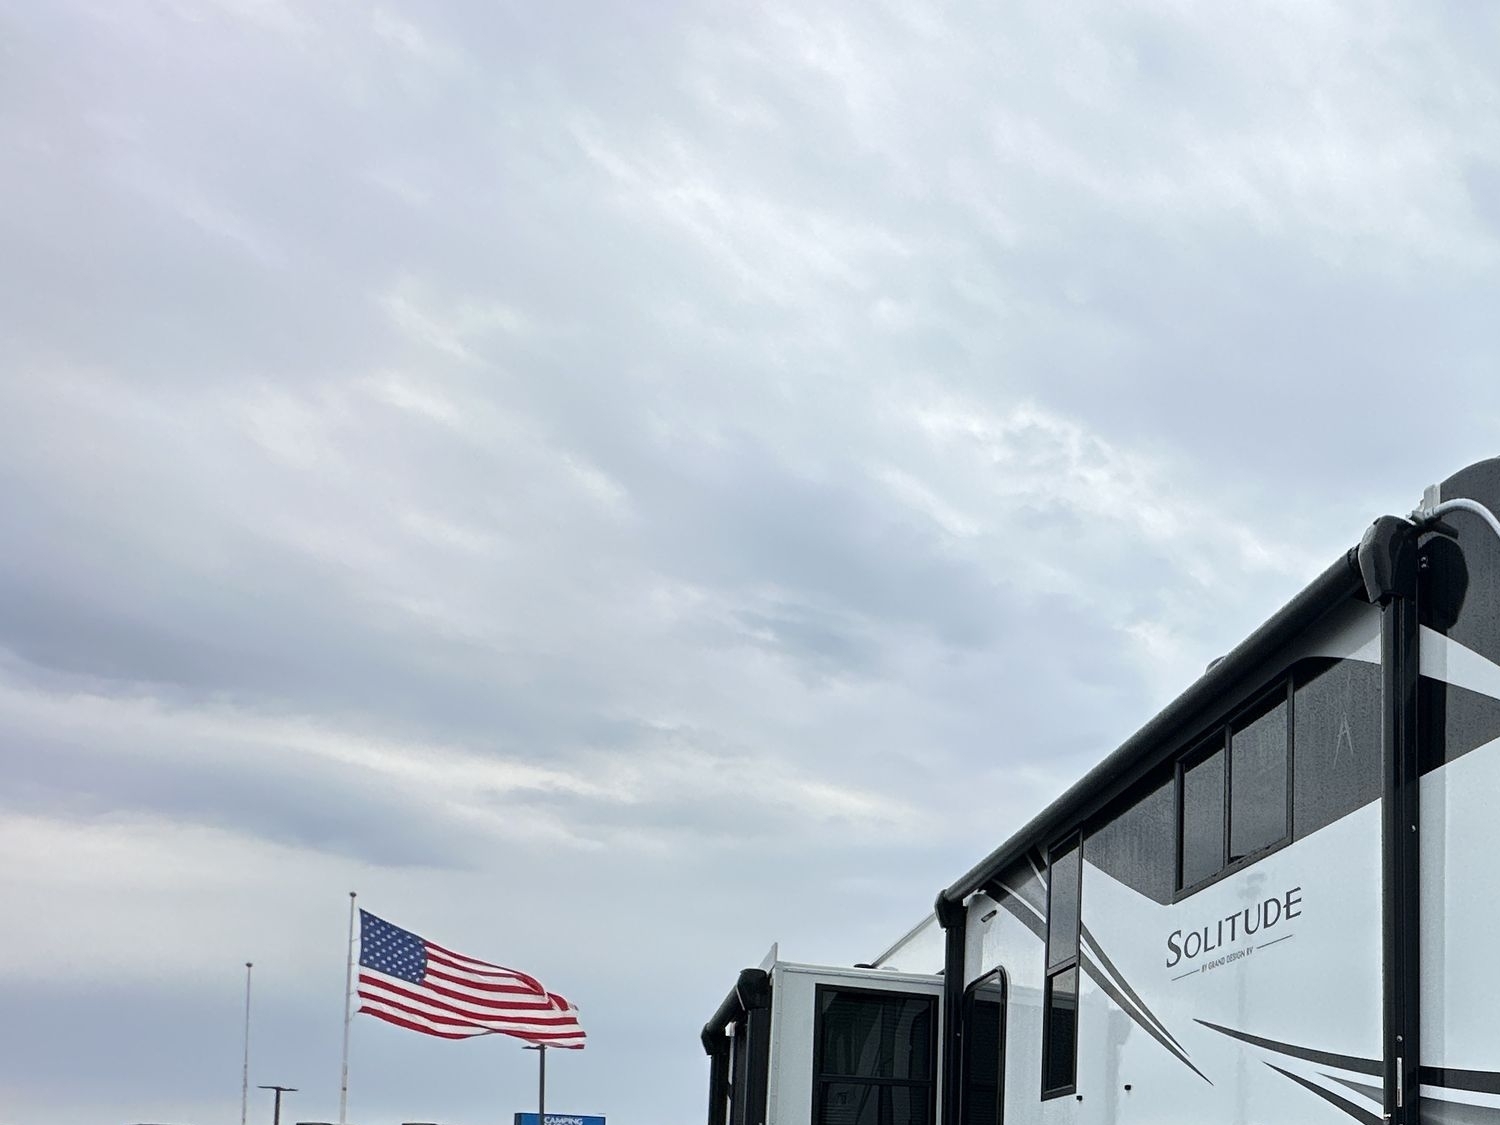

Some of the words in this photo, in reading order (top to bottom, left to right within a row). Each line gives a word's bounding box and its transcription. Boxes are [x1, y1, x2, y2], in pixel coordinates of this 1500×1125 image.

[1166, 887, 1302, 968] SOLITUDE
[1201, 963, 1208, 973] BY
[1208, 956, 1225, 970] GRAND
[1226, 950, 1246, 964] DESIGN
[1246, 945, 1254, 956] RV
[544, 1117, 583, 1125] CAMPING
